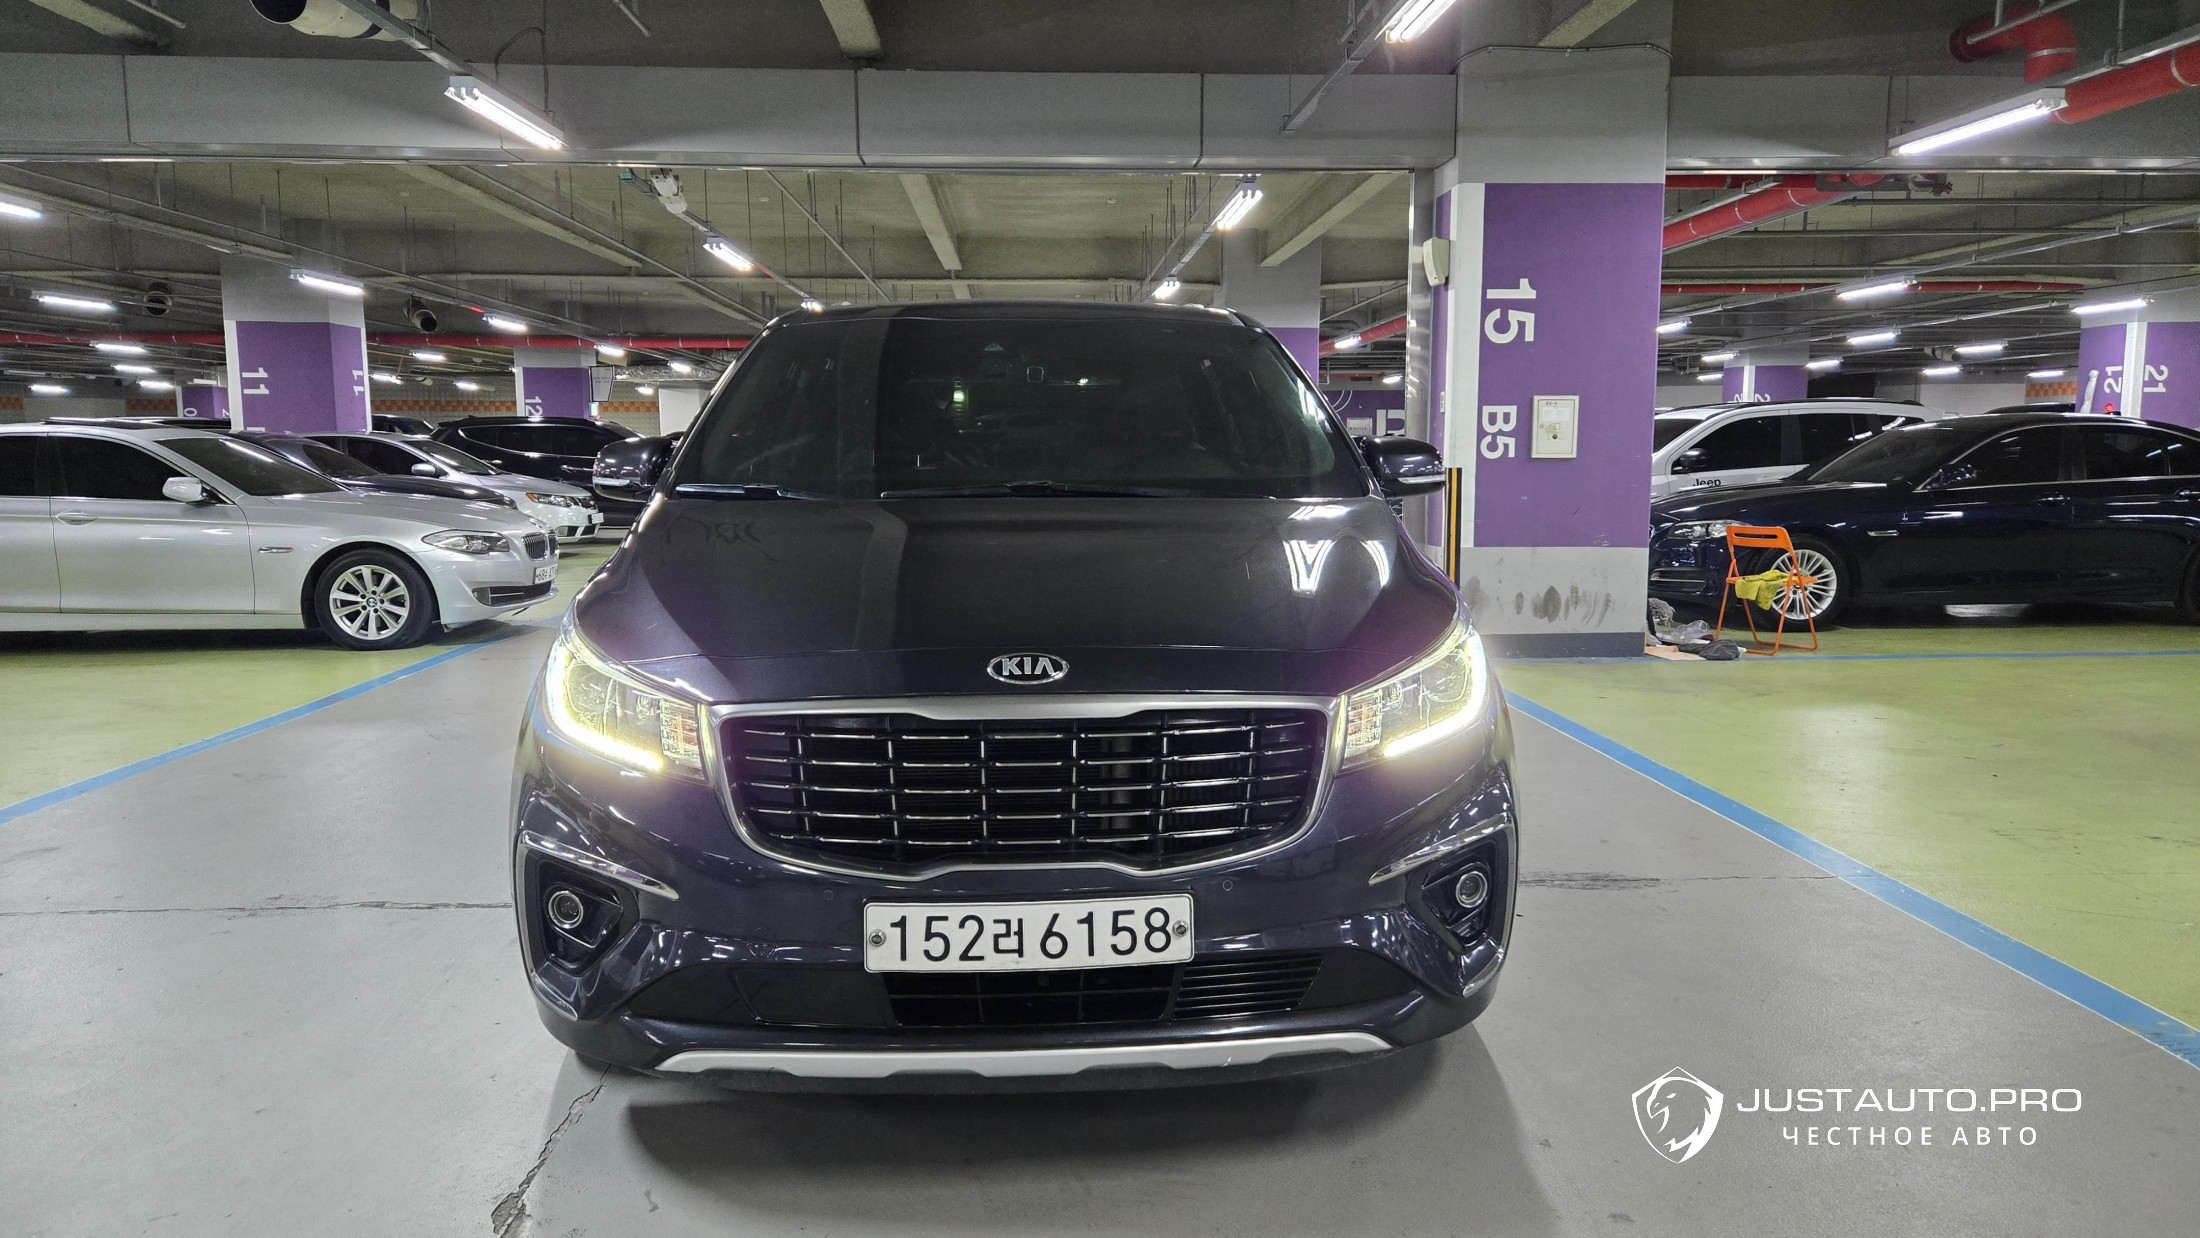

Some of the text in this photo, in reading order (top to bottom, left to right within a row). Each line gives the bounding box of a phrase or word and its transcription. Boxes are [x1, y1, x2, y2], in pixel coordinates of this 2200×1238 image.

[1484, 278, 1537, 344] 15
[241, 367, 270, 395] 11
[2104, 366, 2123, 394] 21
[2143, 365, 2169, 393] 21
[1480, 405, 1518, 460] B5
[1692, 478, 1722, 488] Jeep
[1002, 656, 1056, 676] KIA
